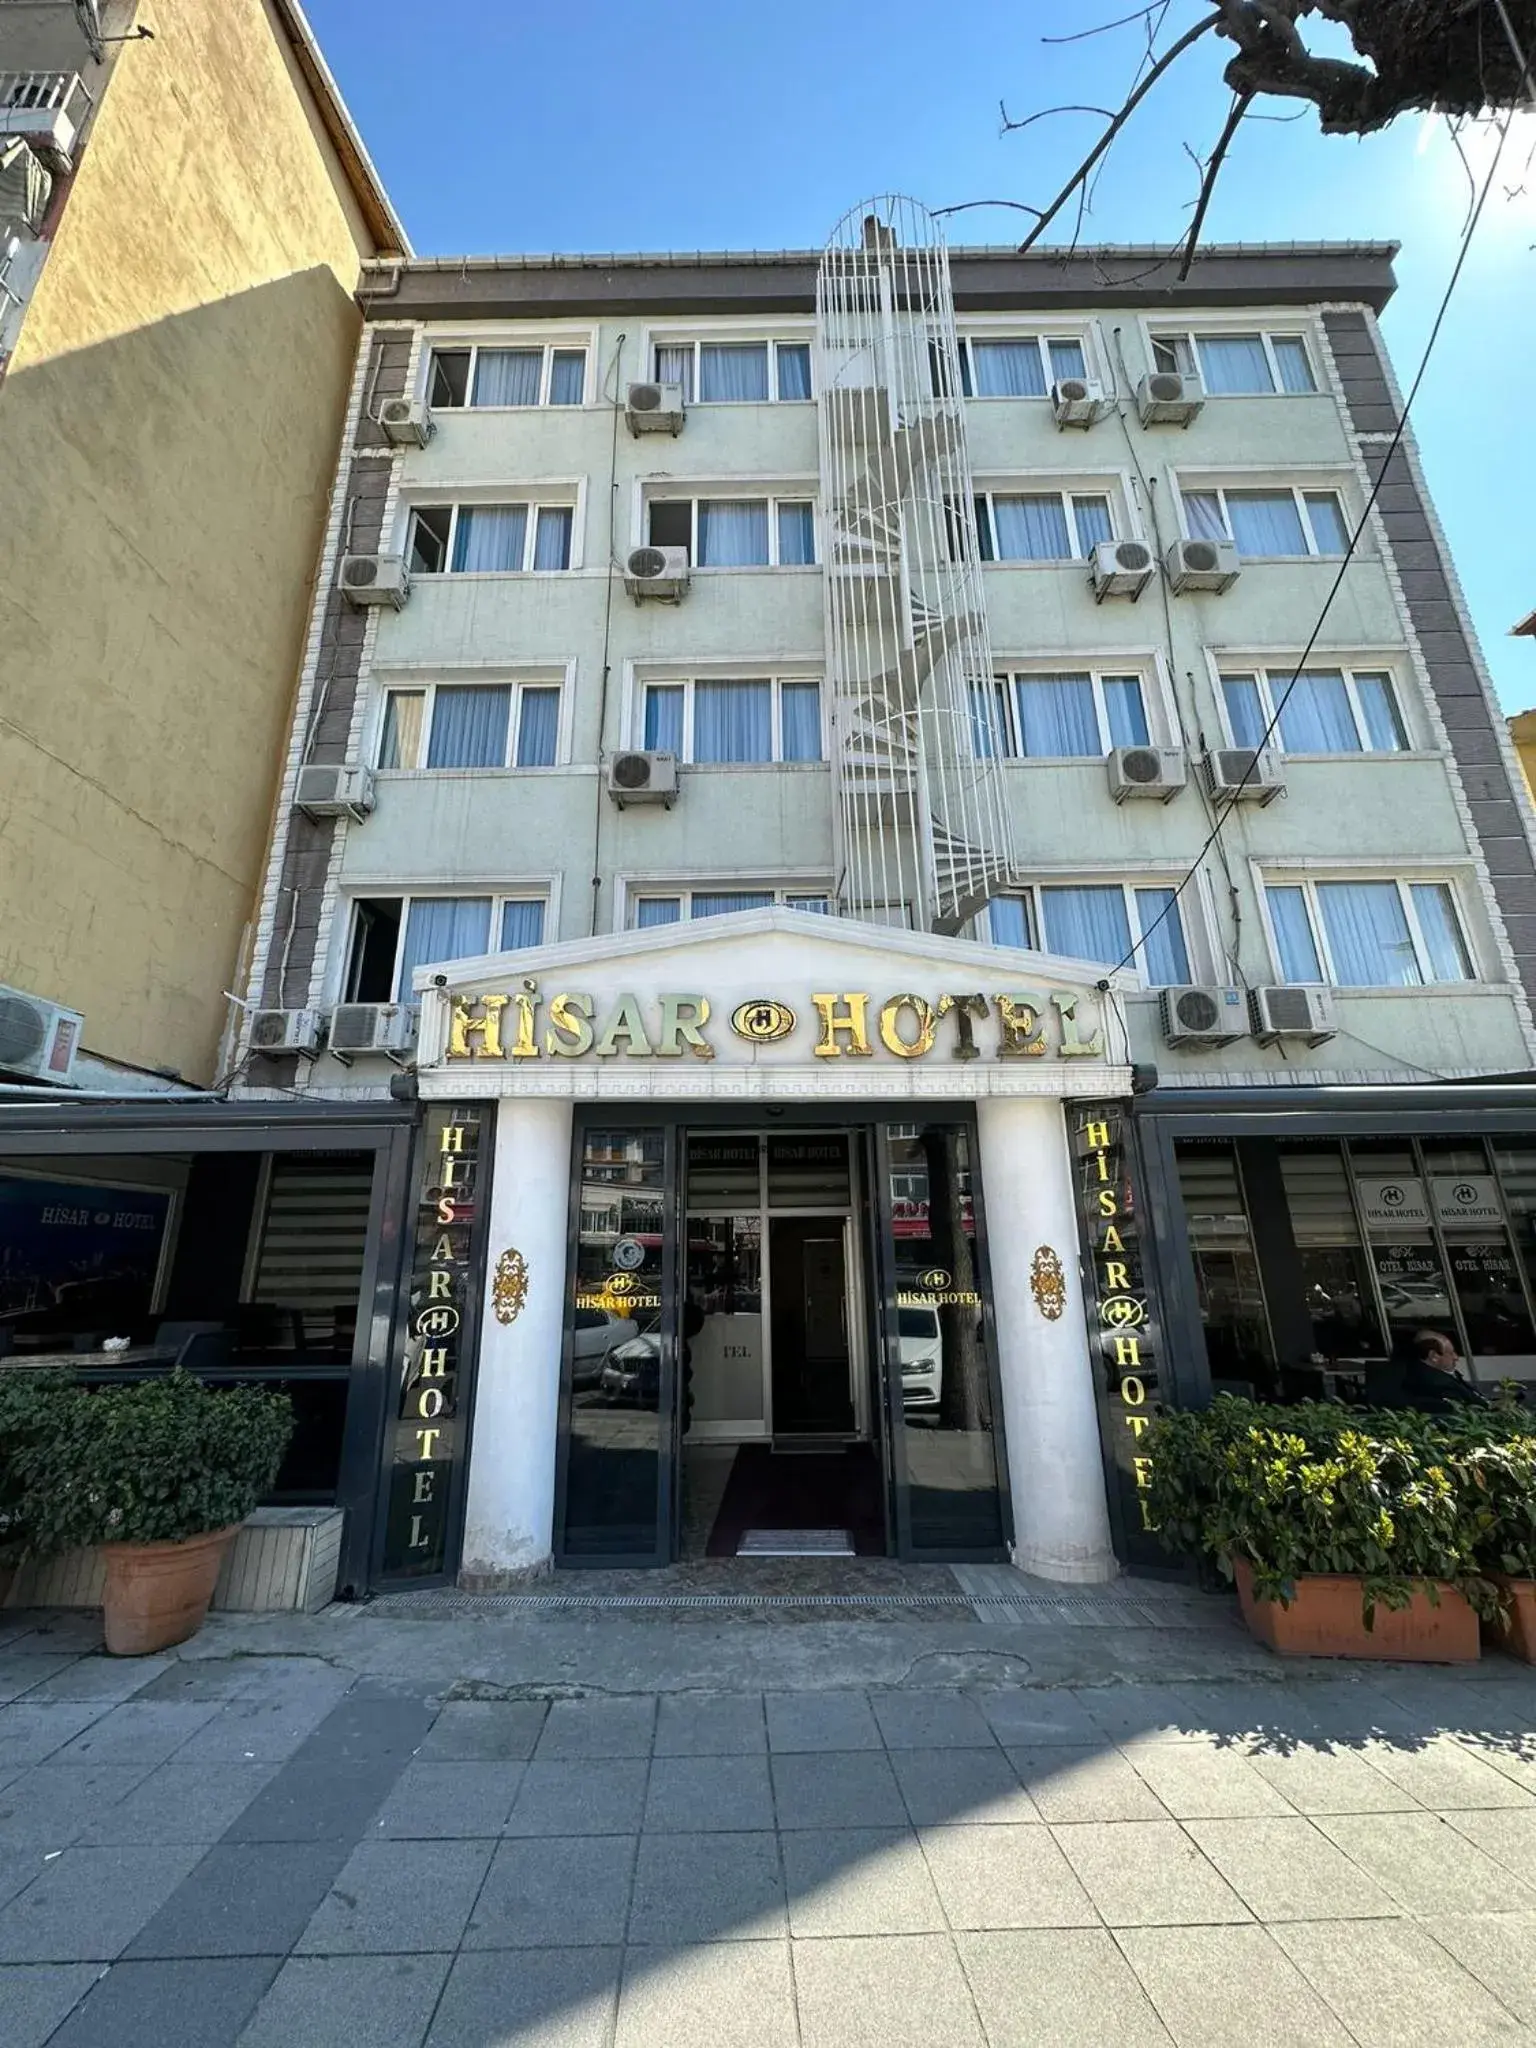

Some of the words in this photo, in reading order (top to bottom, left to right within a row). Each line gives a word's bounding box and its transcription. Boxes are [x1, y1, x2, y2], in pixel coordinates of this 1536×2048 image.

[446, 978, 716, 1062] HİSAR
[811, 991, 1103, 1061] HOTEL
[428, 1127, 465, 1299] HİSAR
[1086, 1121, 1132, 1289] HİSAR
[1396, 1209, 1424, 1218] HOTEL
[1469, 1207, 1499, 1217] HOTEL
[112, 1212, 156, 1230] HOTEL
[1379, 1260, 1404, 1272] OTEL
[1455, 1259, 1480, 1271] OTEL
[576, 1292, 616, 1309] HİSAR
[617, 1294, 661, 1309] HOTEL
[897, 1290, 937, 1305] HİSAR
[938, 1292, 982, 1304] HOTEL
[408, 1347, 448, 1549] HOTEL
